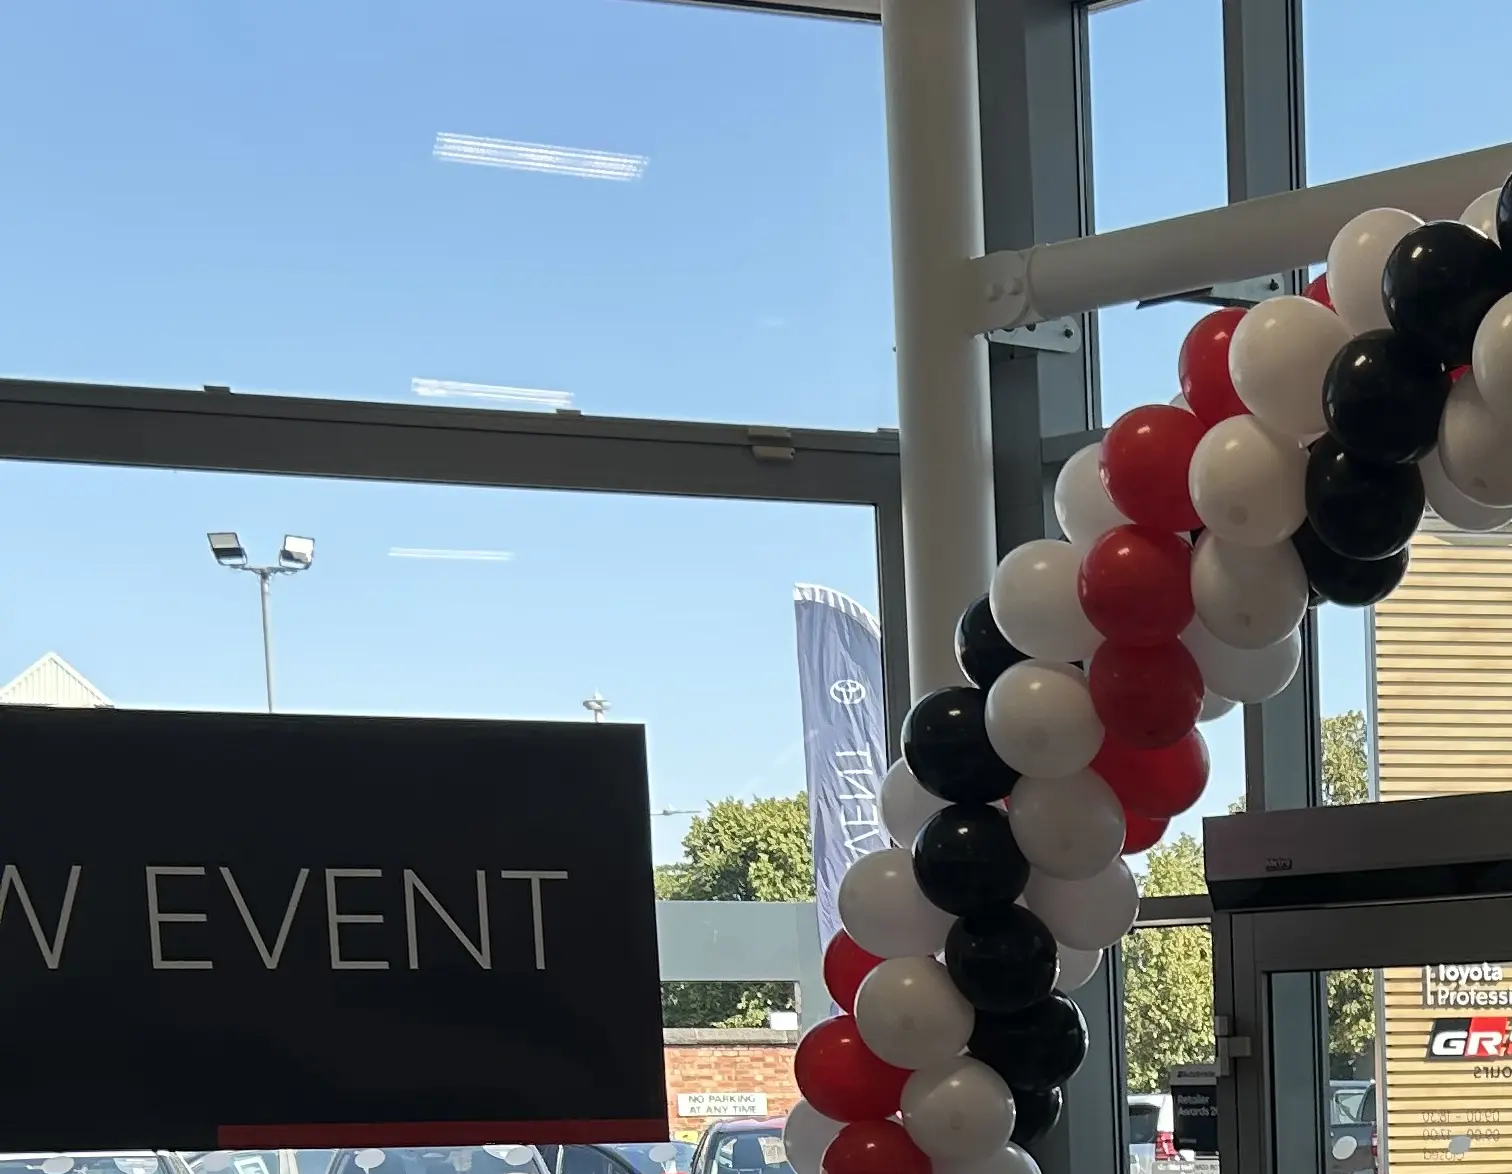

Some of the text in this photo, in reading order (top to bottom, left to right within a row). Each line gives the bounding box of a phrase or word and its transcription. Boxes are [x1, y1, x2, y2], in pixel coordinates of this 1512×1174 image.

[145, 865, 569, 970] EVENT
[1439, 962, 1503, 986] Toyota
[1431, 1031, 1502, 1056] GR
[688, 1094, 756, 1103] NO PARKING
[689, 1105, 757, 1114] AT ANY TIME
